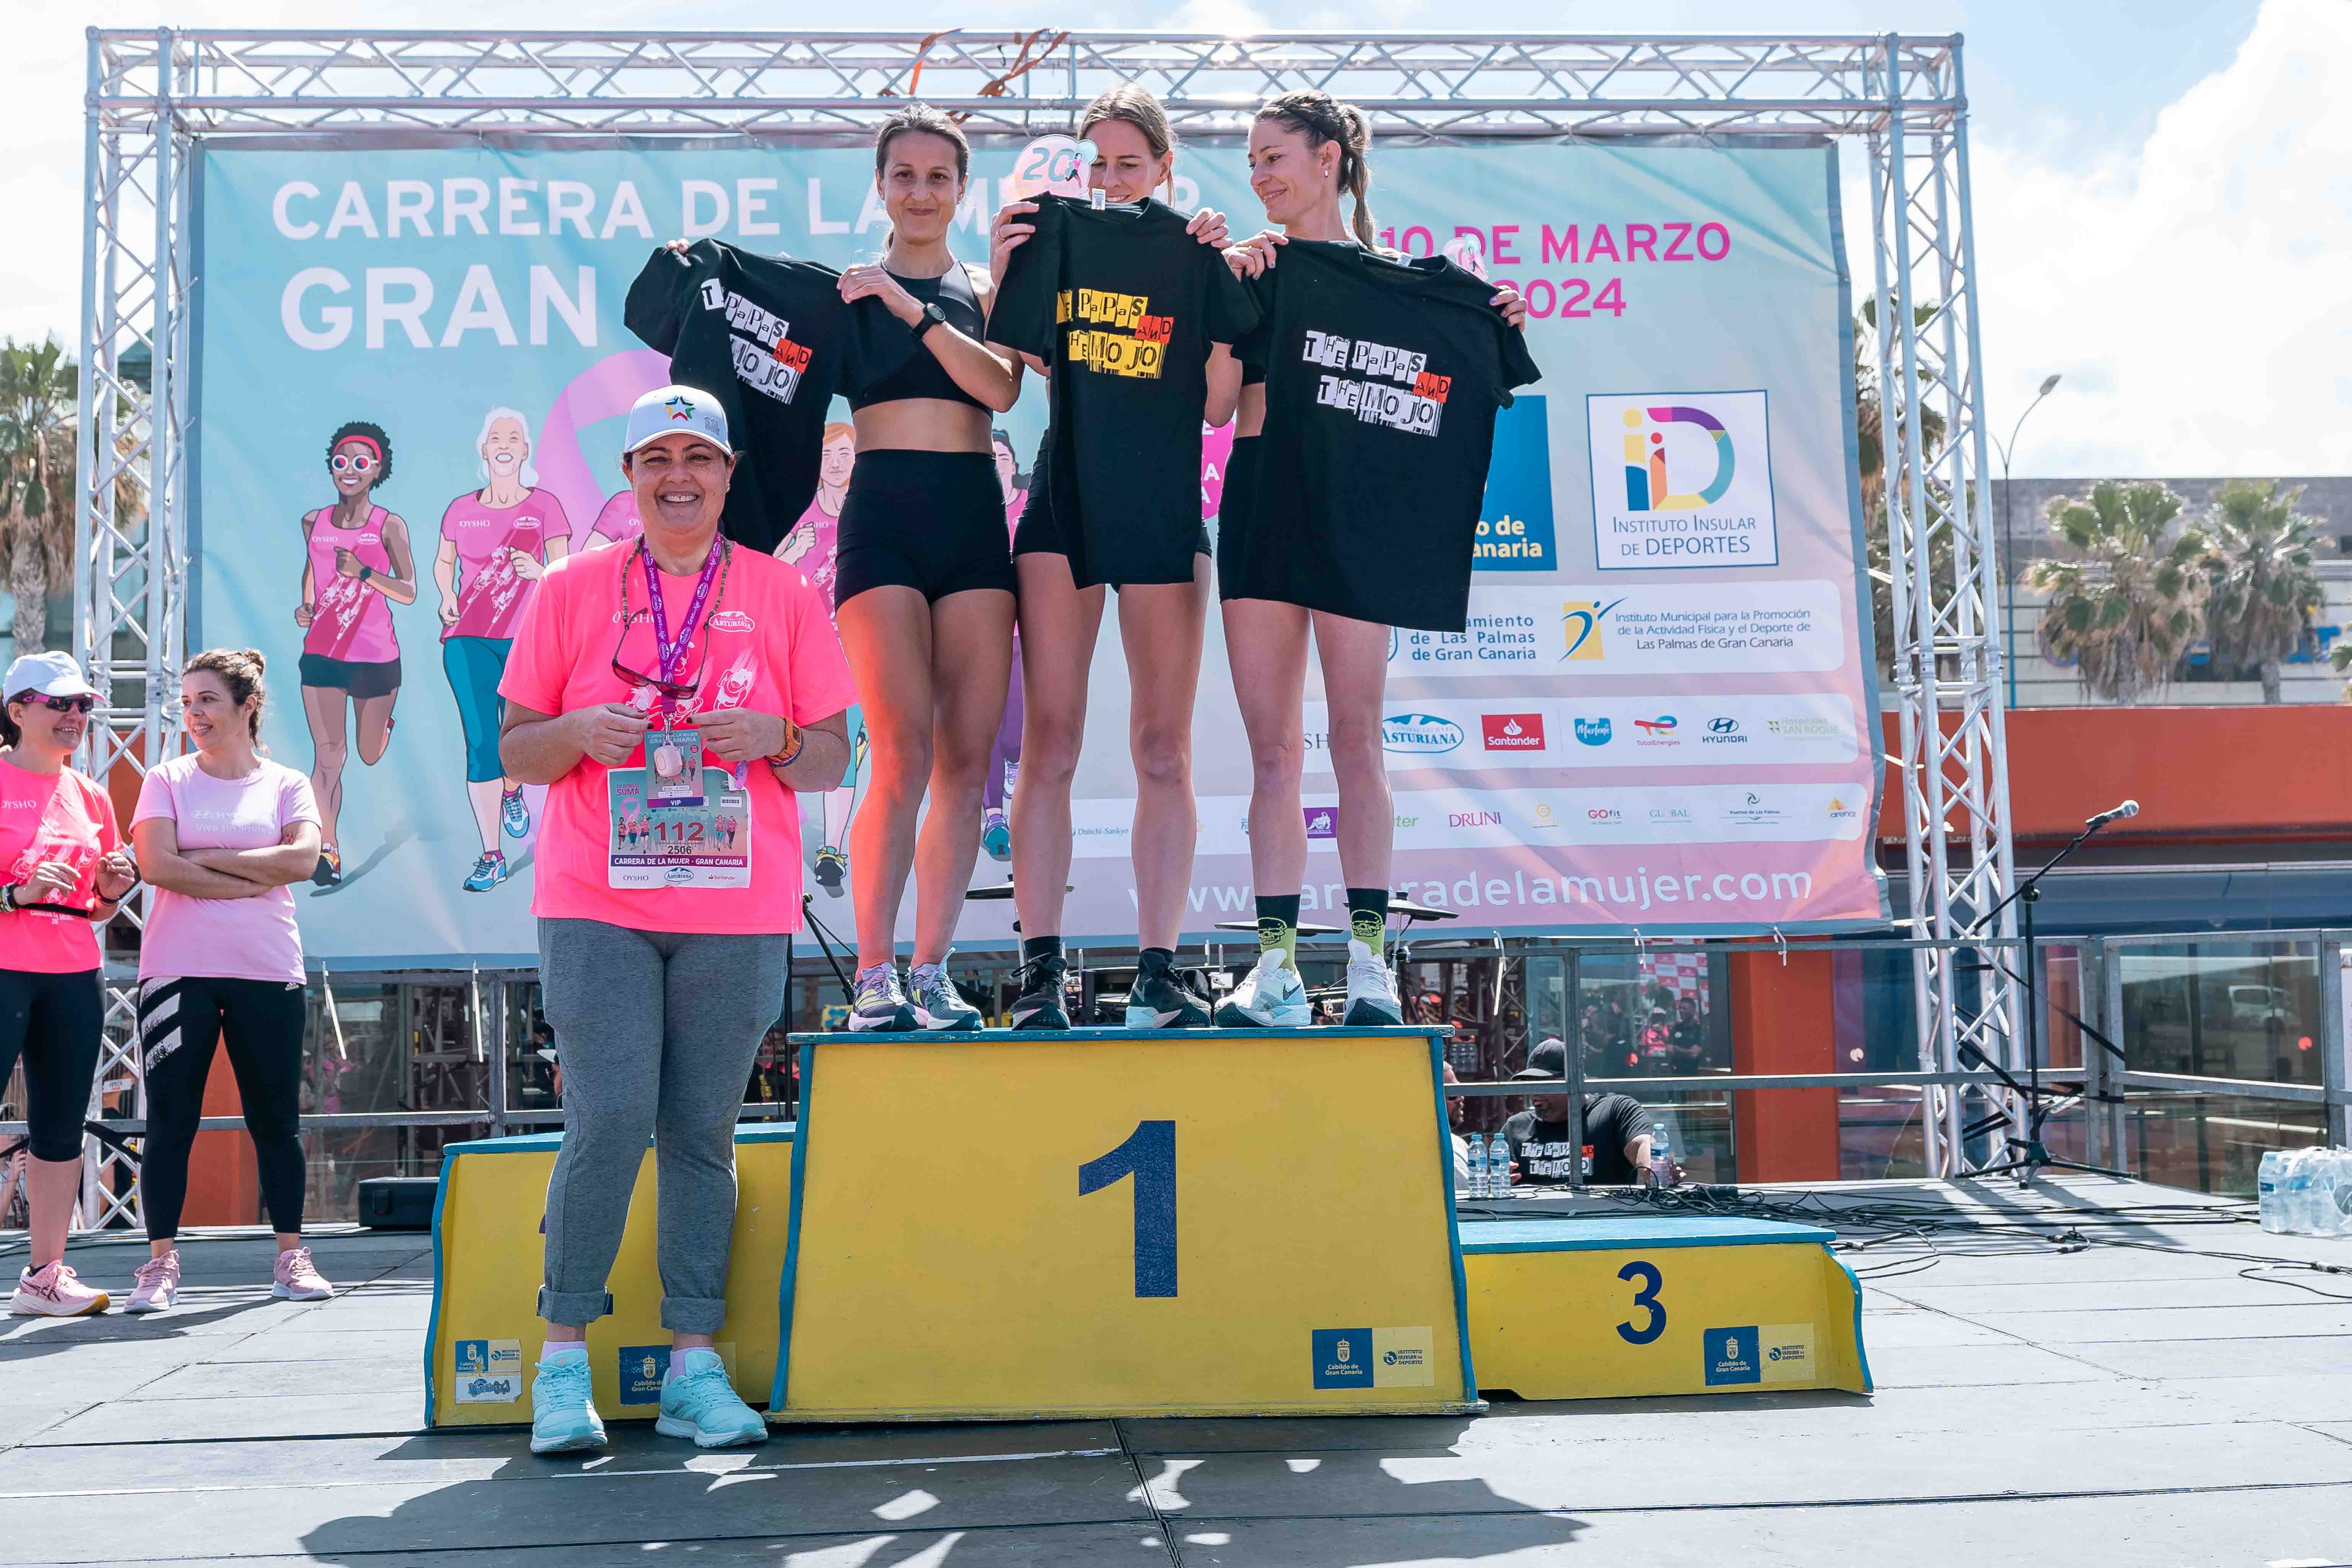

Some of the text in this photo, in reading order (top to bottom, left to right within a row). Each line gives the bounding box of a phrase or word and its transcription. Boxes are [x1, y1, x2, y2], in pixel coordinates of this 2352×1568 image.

[1022, 147, 1076, 182] 20
[273, 177, 654, 240] CARRERA
[682, 178, 779, 237] DE
[1379, 225, 1434, 257] 10
[1541, 222, 1730, 264] MARZO
[281, 265, 597, 350] GRAN
[1070, 332, 1089, 358] HE
[1304, 334, 1348, 367] THE
[1319, 381, 1434, 424] THE MOJO
[1496, 514, 1525, 536] de
[1473, 538, 1543, 558] anaria
[1622, 536, 1750, 556] DE DEPORTES
[612, 611, 654, 623] OSH
[1466, 615, 1534, 627] amiento
[1616, 608, 1810, 623] Instituto Municipal para la Promoción
[1411, 630, 1535, 644] de Las Palmas
[1618, 626, 1631, 635] de
[1635, 626, 1643, 634] la
[1647, 625, 1694, 634] Actividad
[1728, 626, 1735, 636] y
[1738, 624, 1746, 633] el
[1751, 623, 1793, 634] Deporte
[1797, 622, 1810, 631] de
[1637, 637, 1793, 649] Las Palmas de Gran Canaria
[1412, 646, 1536, 660] de Gran Canaria
[1383, 728, 1458, 744] ASTURIANA
[1488, 736, 1540, 746] Santander
[1396, 815, 1418, 827] ter
[1449, 812, 1501, 828] DRUNI
[654, 822, 704, 841] 112
[668, 845, 692, 854] 2506
[1127, 866, 1812, 913] ww.arradelamujer.com
[1079, 1120, 1178, 1297] 1
[1616, 1261, 1667, 1345] 3
